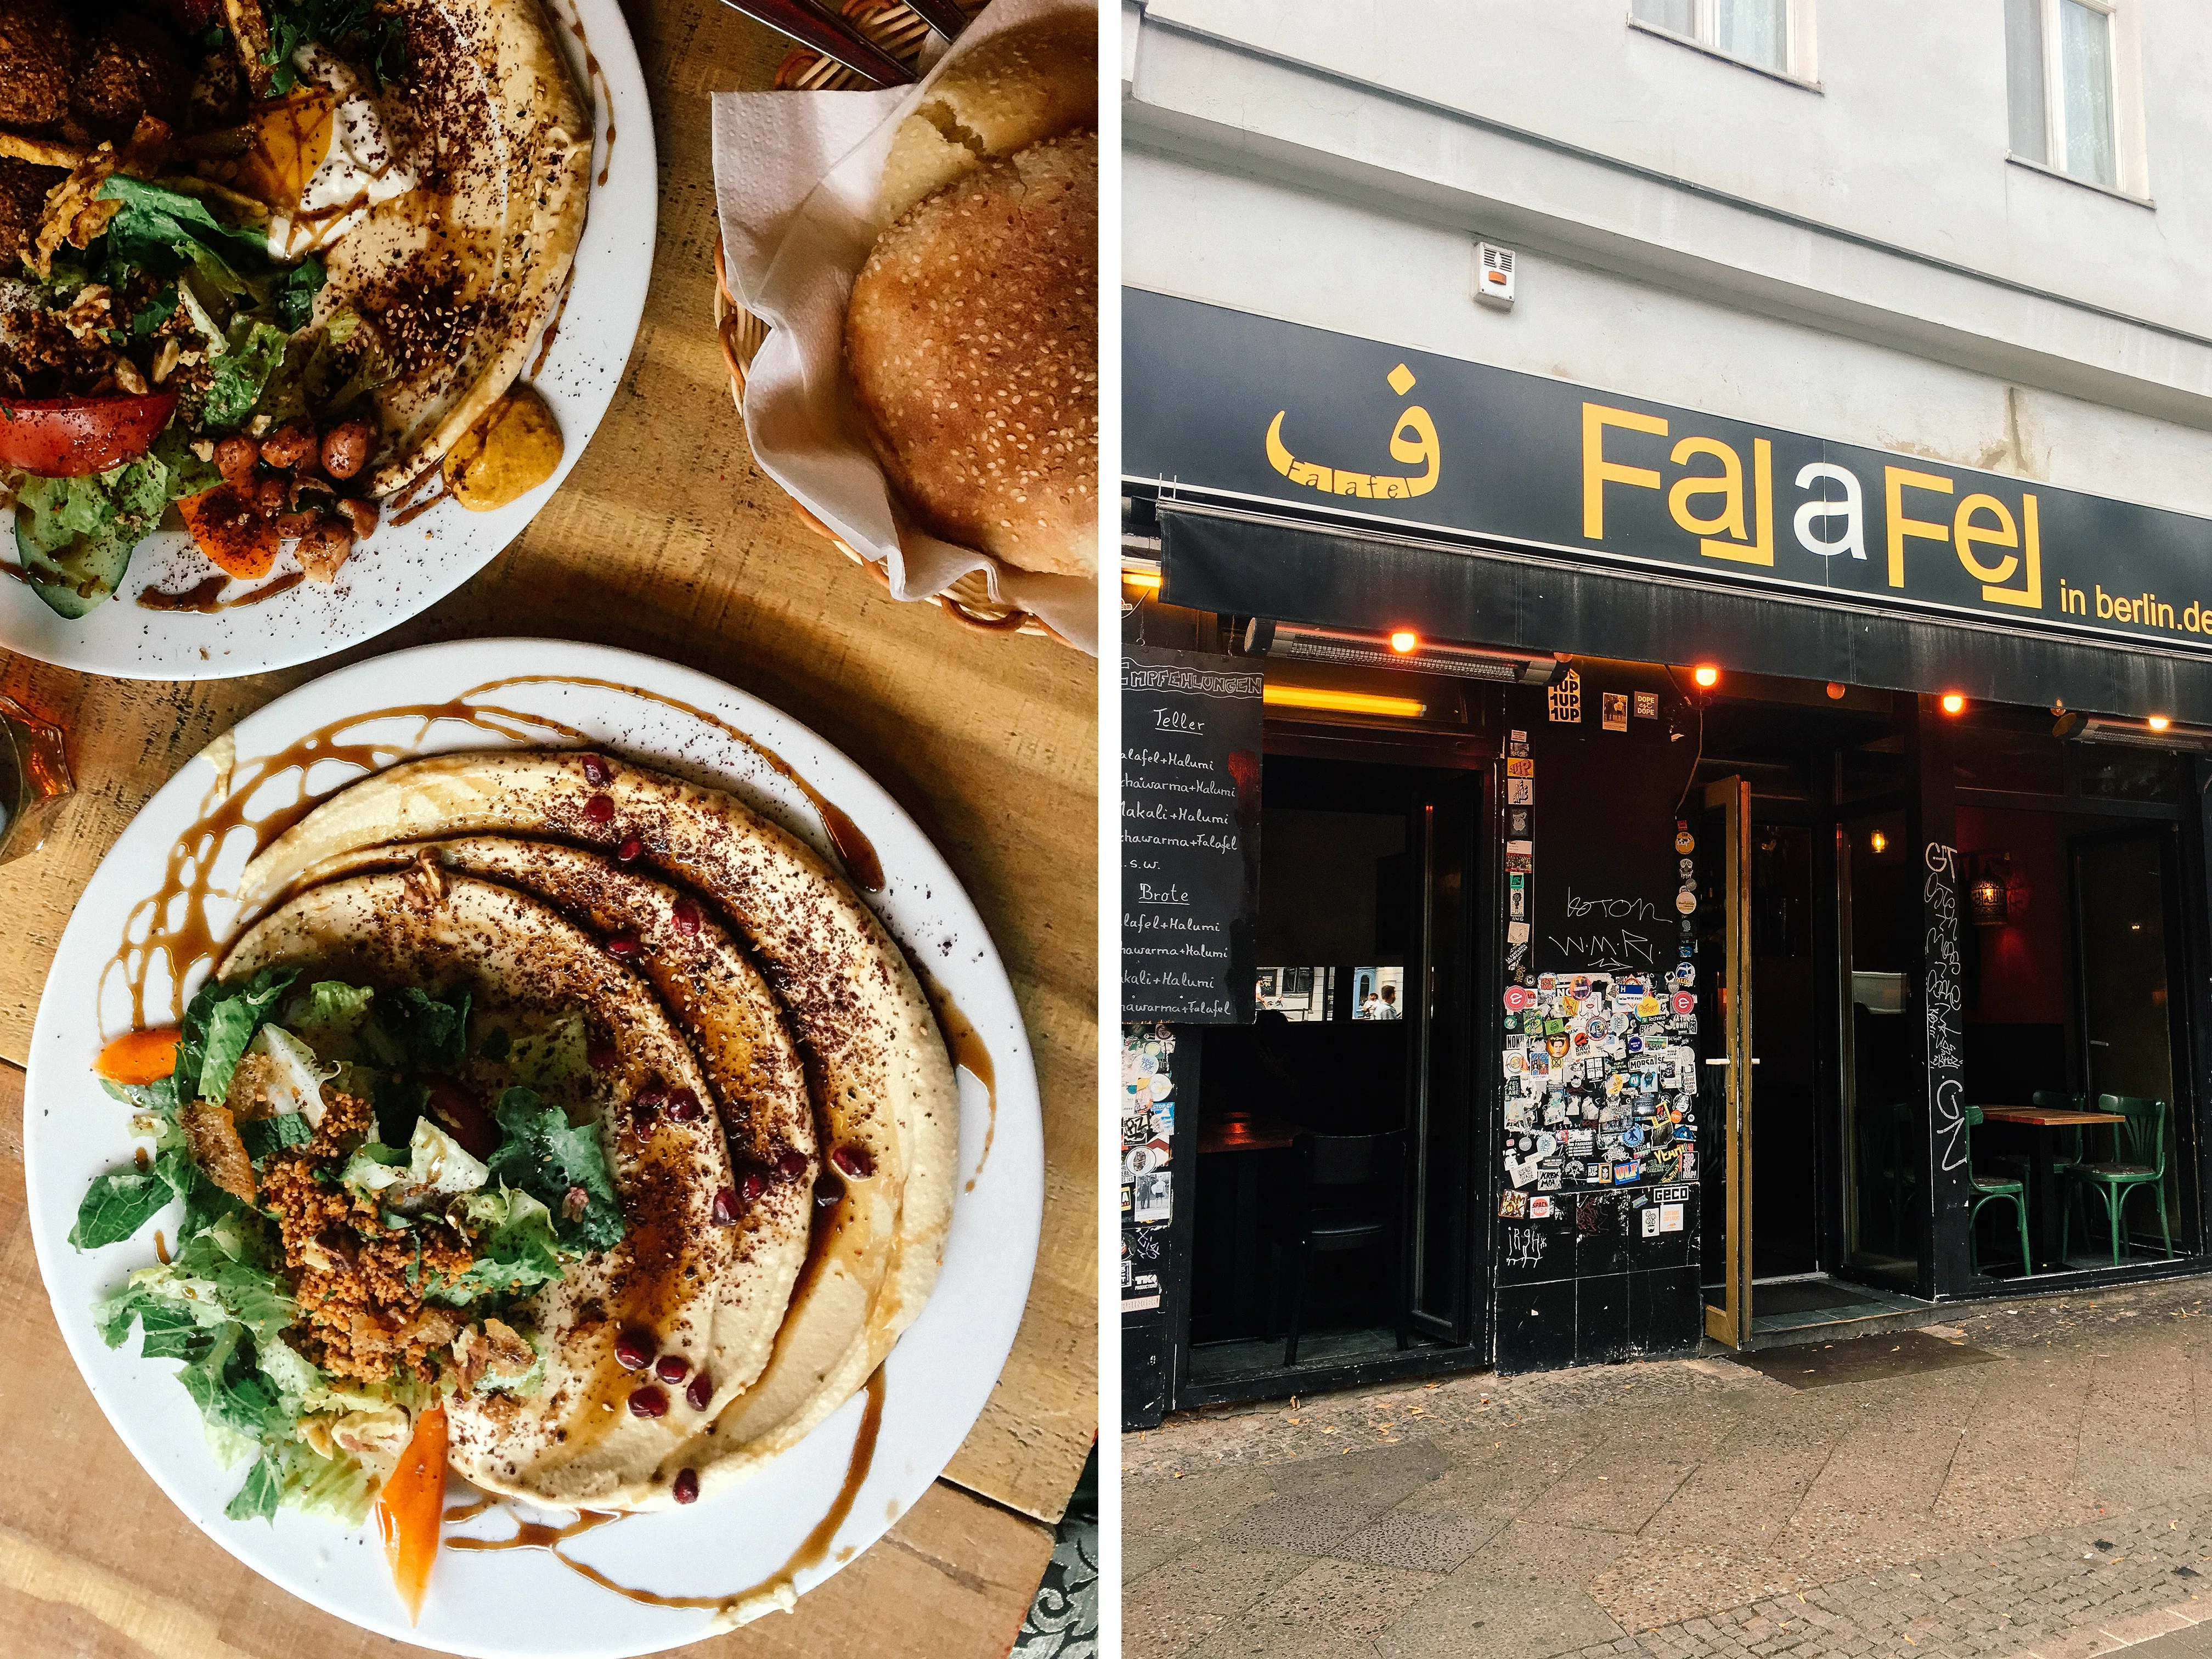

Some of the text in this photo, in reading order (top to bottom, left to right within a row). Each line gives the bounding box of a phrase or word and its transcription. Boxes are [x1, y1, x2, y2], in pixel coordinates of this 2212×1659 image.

[2060, 578, 2212, 635] in berlin.de
[1550, 693, 1579, 707] 1UP
[1551, 707, 1579, 721] 1UP
[1637, 707, 1655, 715] DOPE
[1154, 708, 1205, 731] Teller
[1139, 883, 1189, 902] Brote
[1121, 913, 1220, 933] lafel+Halumi
[1630, 1059, 1654, 1069] MORSA
[1633, 1142, 1651, 1153] STOR
[1615, 1163, 1638, 1180] ULF
